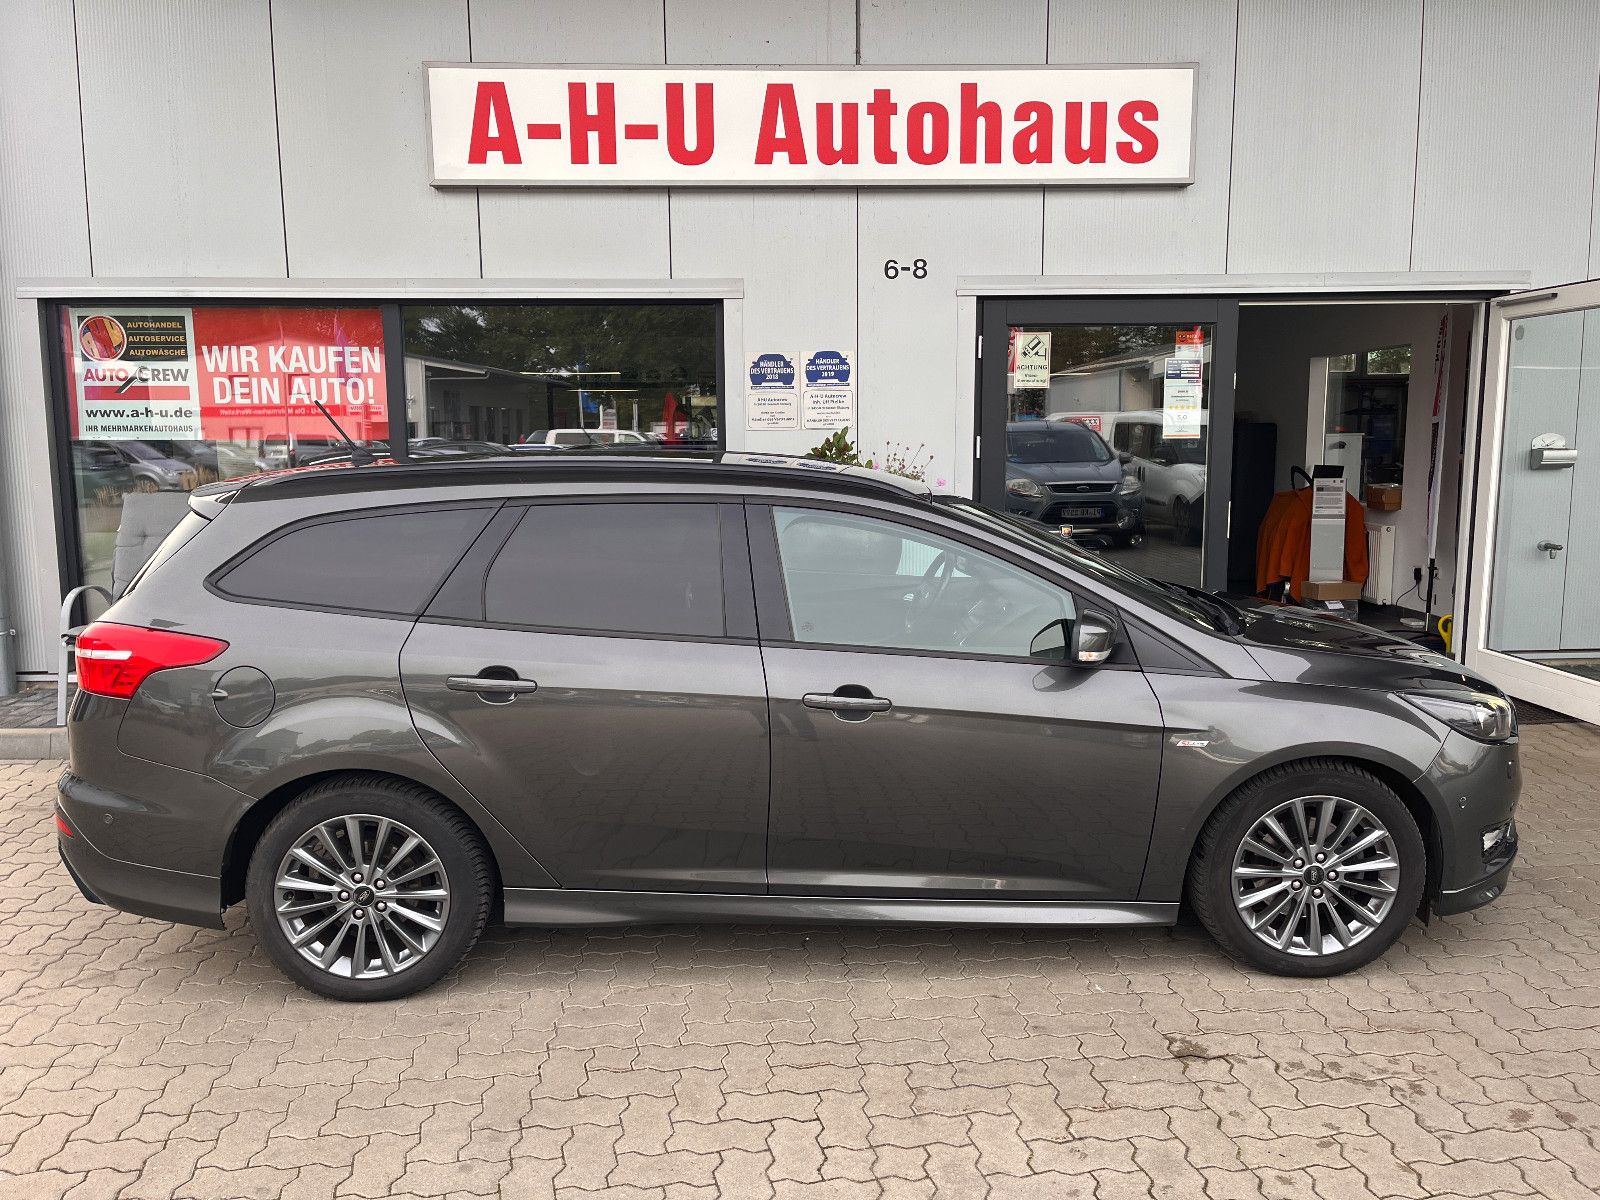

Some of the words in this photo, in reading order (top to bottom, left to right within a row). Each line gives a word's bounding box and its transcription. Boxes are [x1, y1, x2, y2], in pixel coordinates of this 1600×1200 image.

[467, 81, 715, 166] A-H-U
[754, 82, 1159, 166] Autohaus
[884, 258, 928, 280] 6-8
[127, 321, 182, 329] AUTOHANDEL
[129, 348, 186, 356] AUTOWÄSCHE
[201, 345, 260, 373] WIR
[268, 345, 381, 374] KAUFEN
[84, 368, 129, 382] AUTO
[137, 366, 189, 383] CREW
[751, 367, 760, 375] DES
[213, 377, 281, 405] DEIN
[290, 377, 376, 405] AUTO!
[85, 407, 193, 418] www.a-h-u.de
